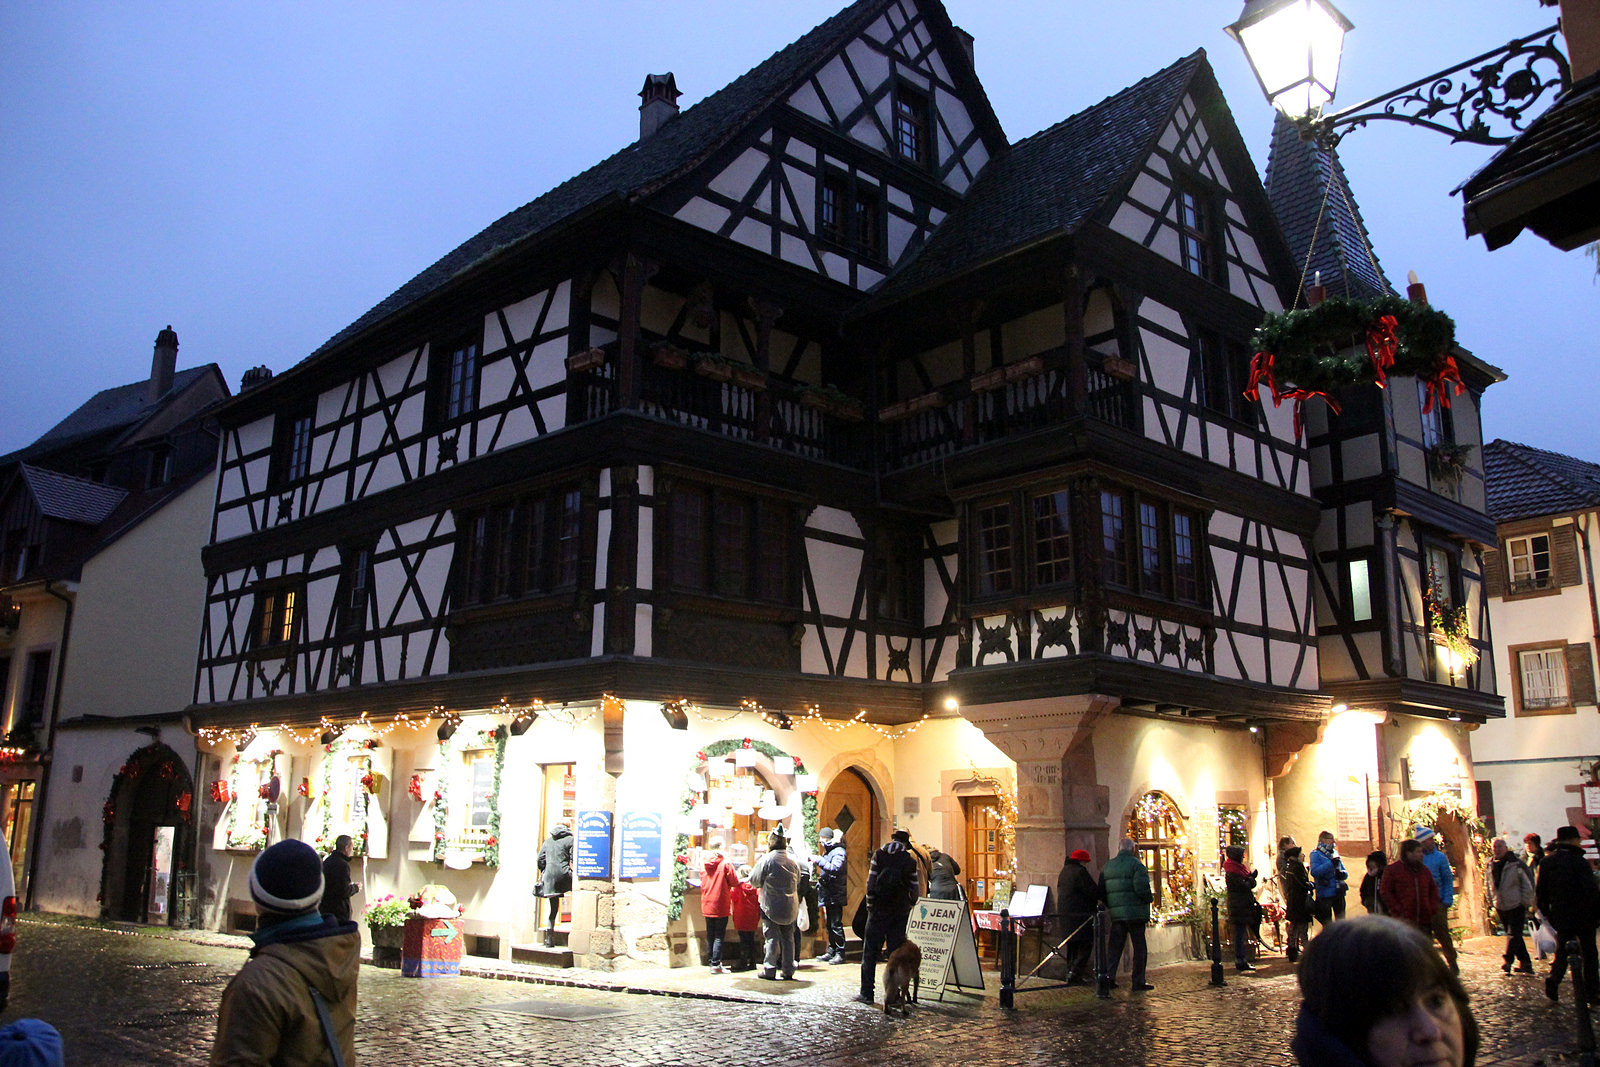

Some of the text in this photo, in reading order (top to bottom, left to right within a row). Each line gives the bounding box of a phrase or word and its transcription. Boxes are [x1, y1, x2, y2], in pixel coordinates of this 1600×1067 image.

[930, 908, 956, 919] JEAN
[910, 920, 955, 933] DIETRICH
[922, 946, 949, 956] CREMANT
[927, 978, 938, 986] VIE
